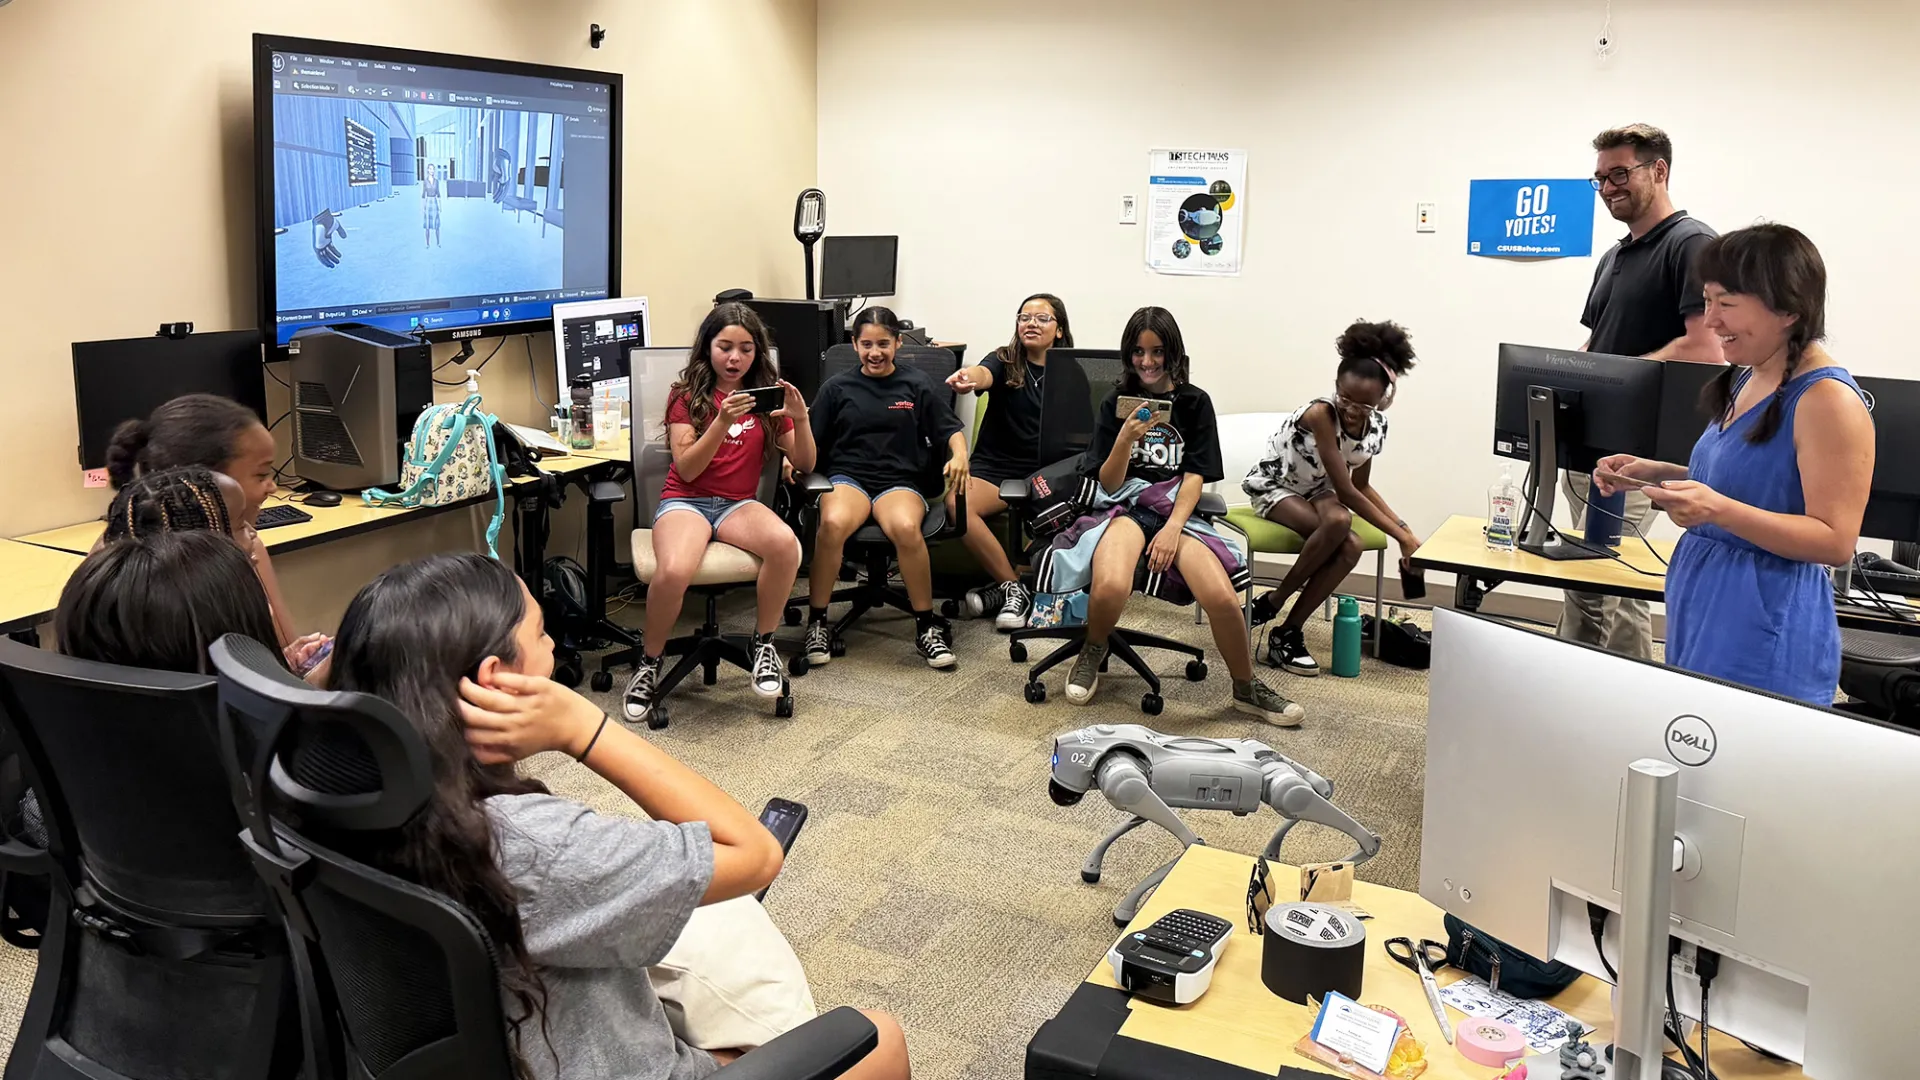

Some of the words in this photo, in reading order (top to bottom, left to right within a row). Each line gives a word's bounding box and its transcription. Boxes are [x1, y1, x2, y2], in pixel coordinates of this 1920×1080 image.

[1515, 184, 1550, 217] GO
[1505, 214, 1557, 237] YOTES!
[1497, 245, 1561, 253] CSUSBshop.com
[452, 328, 482, 339] SAMSUNG
[1545, 352, 1597, 370] ViewSonic
[1130, 441, 1185, 467] HOI
[1493, 516, 1510, 526] HAND
[1671, 729, 1711, 752] DELL
[1071, 752, 1087, 764] 02
